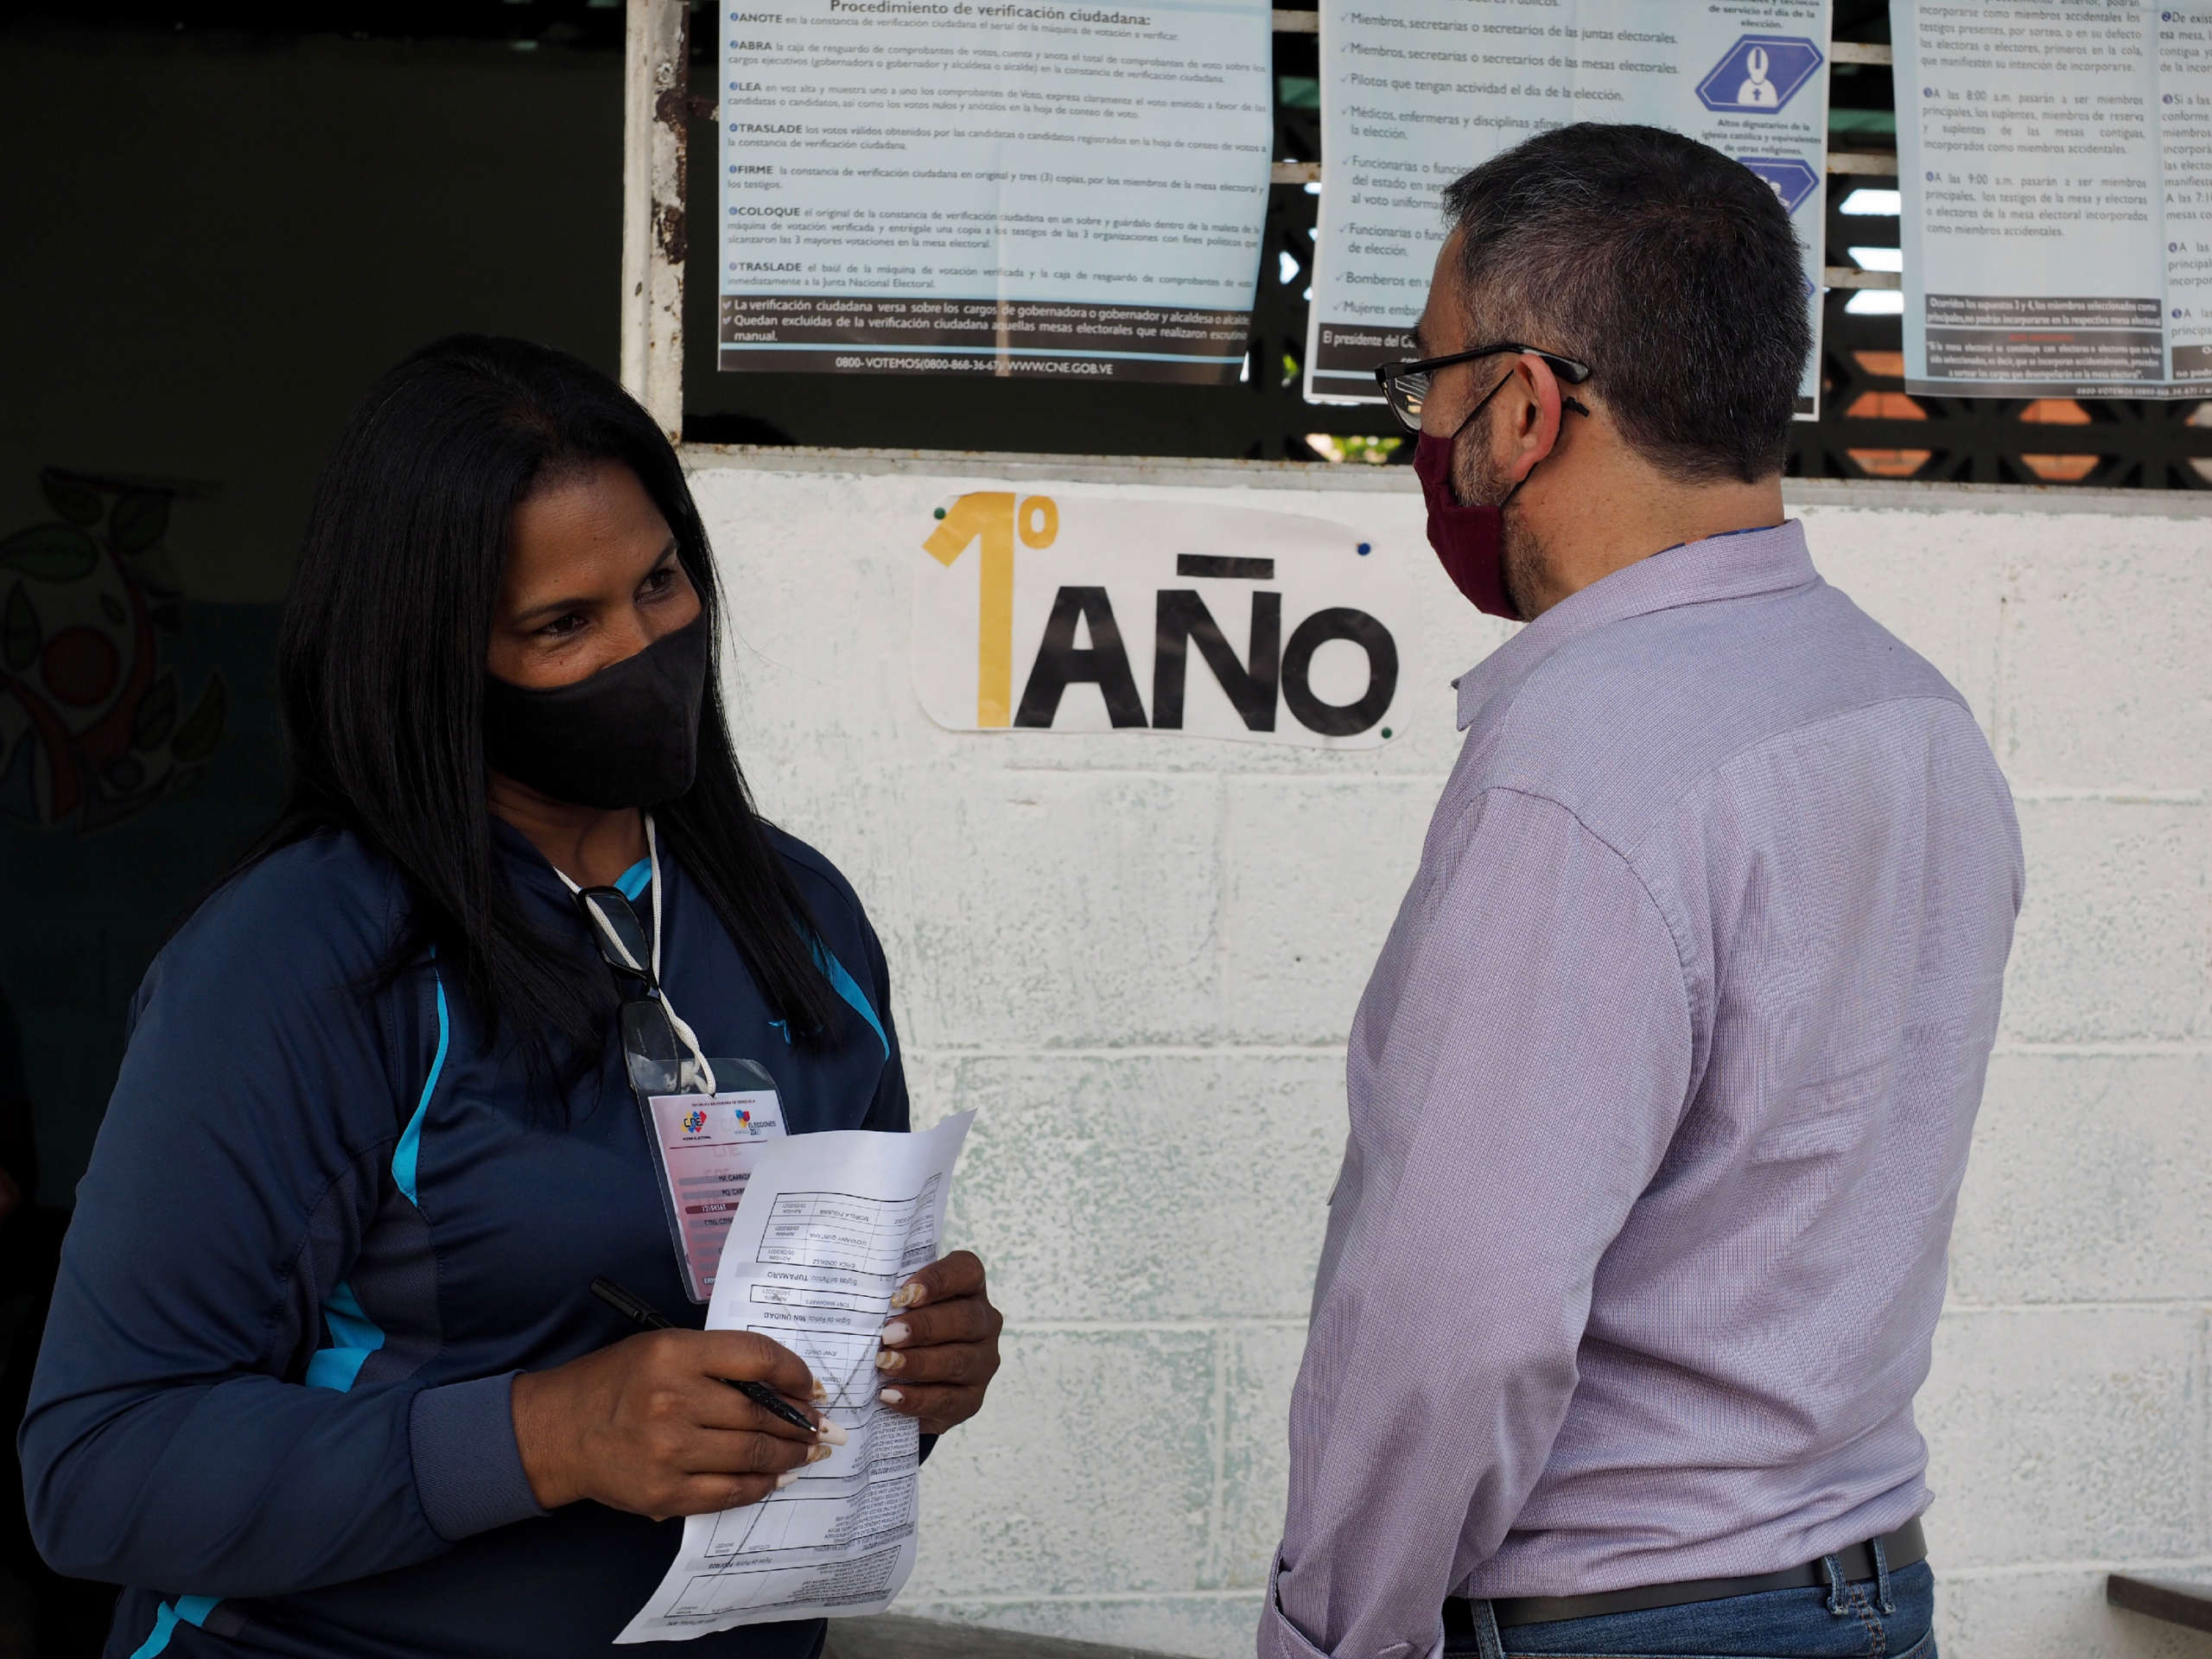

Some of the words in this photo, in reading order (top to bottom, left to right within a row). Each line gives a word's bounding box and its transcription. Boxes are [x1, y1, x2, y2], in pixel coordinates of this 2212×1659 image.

[830, 0, 948, 14] Procedimiento
[954, 2, 972, 15] de
[978, 6, 1065, 20] verificación
[1070, 9, 1150, 25] ciudadana:
[1410, 19, 1468, 32] secretarias
[1471, 23, 1479, 32] o
[1483, 23, 1544, 35] secretarios
[1548, 25, 1561, 36] de
[1565, 26, 1578, 37] las
[1582, 29, 1614, 40] juntas
[740, 41, 772, 50] ABRA
[1408, 49, 1467, 62] secretarias
[1483, 54, 1544, 66] secretarios
[1548, 55, 1561, 67] de
[1565, 56, 1578, 68] las
[1582, 60, 1615, 70] mesas
[739, 82, 761, 92] LEA
[1351, 73, 1388, 87] Pilotos
[1391, 79, 1411, 92] que
[1415, 81, 1452, 94] tengan
[1456, 81, 1507, 94] actividad
[1510, 84, 1521, 95] el
[1524, 85, 1541, 96] día
[1545, 86, 1559, 97] de
[1562, 86, 1571, 98] la
[1399, 111, 1459, 124] enfermeras
[1464, 118, 1470, 128] y
[1473, 115, 1529, 129] disciplinas
[740, 123, 802, 134] TRASLADE
[1351, 124, 1359, 135] la
[738, 165, 772, 174] FIRME
[1352, 158, 1417, 172] Funcionarias
[1421, 164, 1430, 173] o
[1352, 174, 1369, 186] del
[1372, 178, 1407, 189] estado
[1410, 181, 1423, 190] en
[1351, 193, 1361, 204] al
[1364, 196, 1389, 206] voto
[739, 206, 799, 217] COLOQUE
[1350, 226, 1412, 238] Funcionarias
[1414, 231, 1422, 239] o
[1348, 242, 1361, 253] de
[741, 262, 801, 271] TRASLADE
[1346, 271, 1405, 286] Bomberos
[1408, 278, 1421, 288] en
[734, 299, 747, 310] La
[750, 299, 811, 310] verificación
[817, 301, 873, 312] ciudadana
[878, 303, 906, 313] versa
[912, 302, 942, 313] sobre
[944, 302, 959, 314] los
[963, 305, 997, 316] cargos
[1001, 304, 1015, 316] de
[1018, 305, 1087, 318] gobernadora
[1089, 309, 1096, 318] o
[1098, 308, 1160, 322] gobernador
[1162, 314, 1168, 324] y
[1170, 311, 1214, 323] alcaldesa
[1215, 316, 1222, 325] o
[1344, 301, 1385, 316] Mujeres
[734, 315, 778, 326] Quedan
[782, 315, 832, 327] excluidas
[836, 316, 850, 327] de
[855, 316, 864, 327] la
[868, 316, 930, 328] verificación
[934, 318, 988, 330] ciudadana
[992, 321, 1035, 333] aquellas
[1039, 323, 1072, 333] mesas
[1077, 322, 1133, 335] electorales
[1137, 327, 1157, 338] que
[1160, 327, 1207, 339] realizaron
[1323, 330, 1332, 344] El
[1333, 332, 1382, 347] presidente
[1384, 334, 1400, 347] del
[1013, 554, 1399, 737] AÑO
[766, 1271, 809, 1281] TUPAMARO
[764, 1312, 791, 1320] UNIDAD
